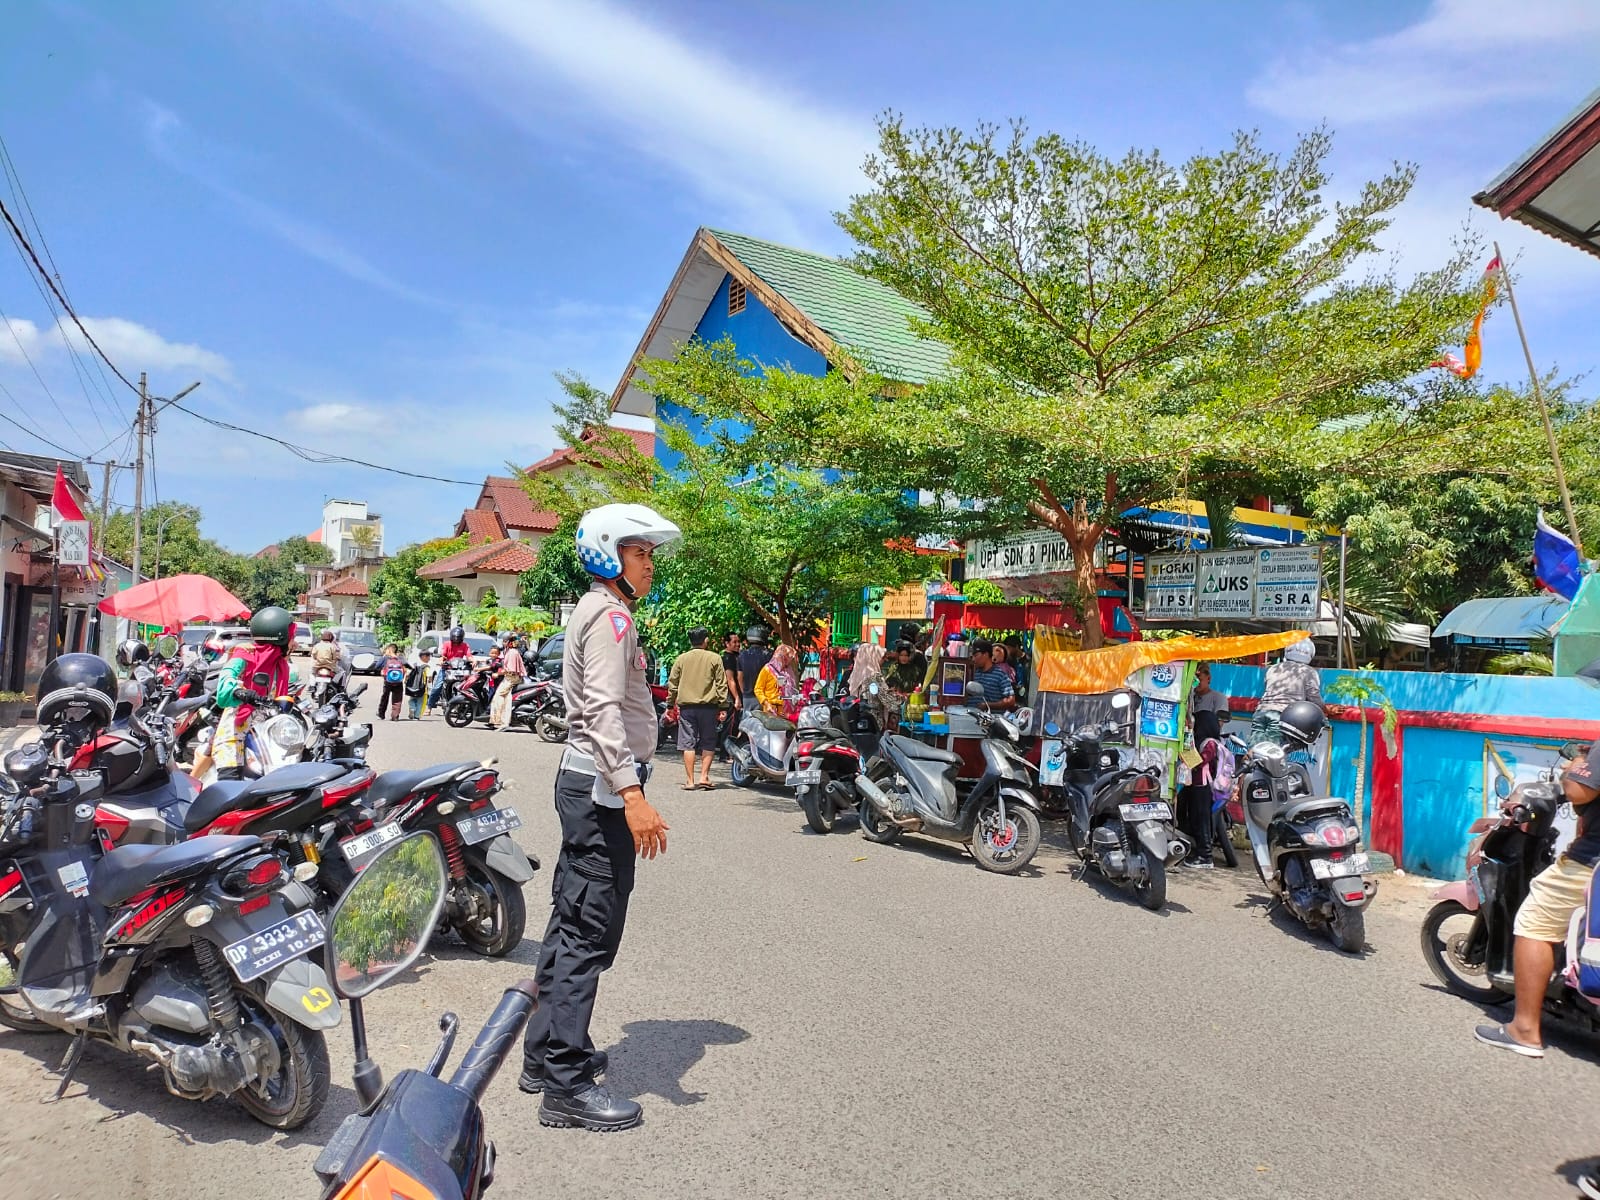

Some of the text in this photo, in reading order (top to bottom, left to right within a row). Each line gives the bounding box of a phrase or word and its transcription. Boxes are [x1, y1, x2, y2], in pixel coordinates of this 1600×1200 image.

[980, 548, 998, 569] UPT
[1004, 546, 1024, 567] SDN
[1029, 544, 1036, 565] 8
[1160, 562, 1194, 574] FORKI
[1218, 576, 1249, 592] UKS
[1154, 702, 1174, 712] ESSE
[460, 821, 471, 833] DP
[477, 812, 499, 826] 4827
[227, 912, 318, 964] DP 3333 PI
